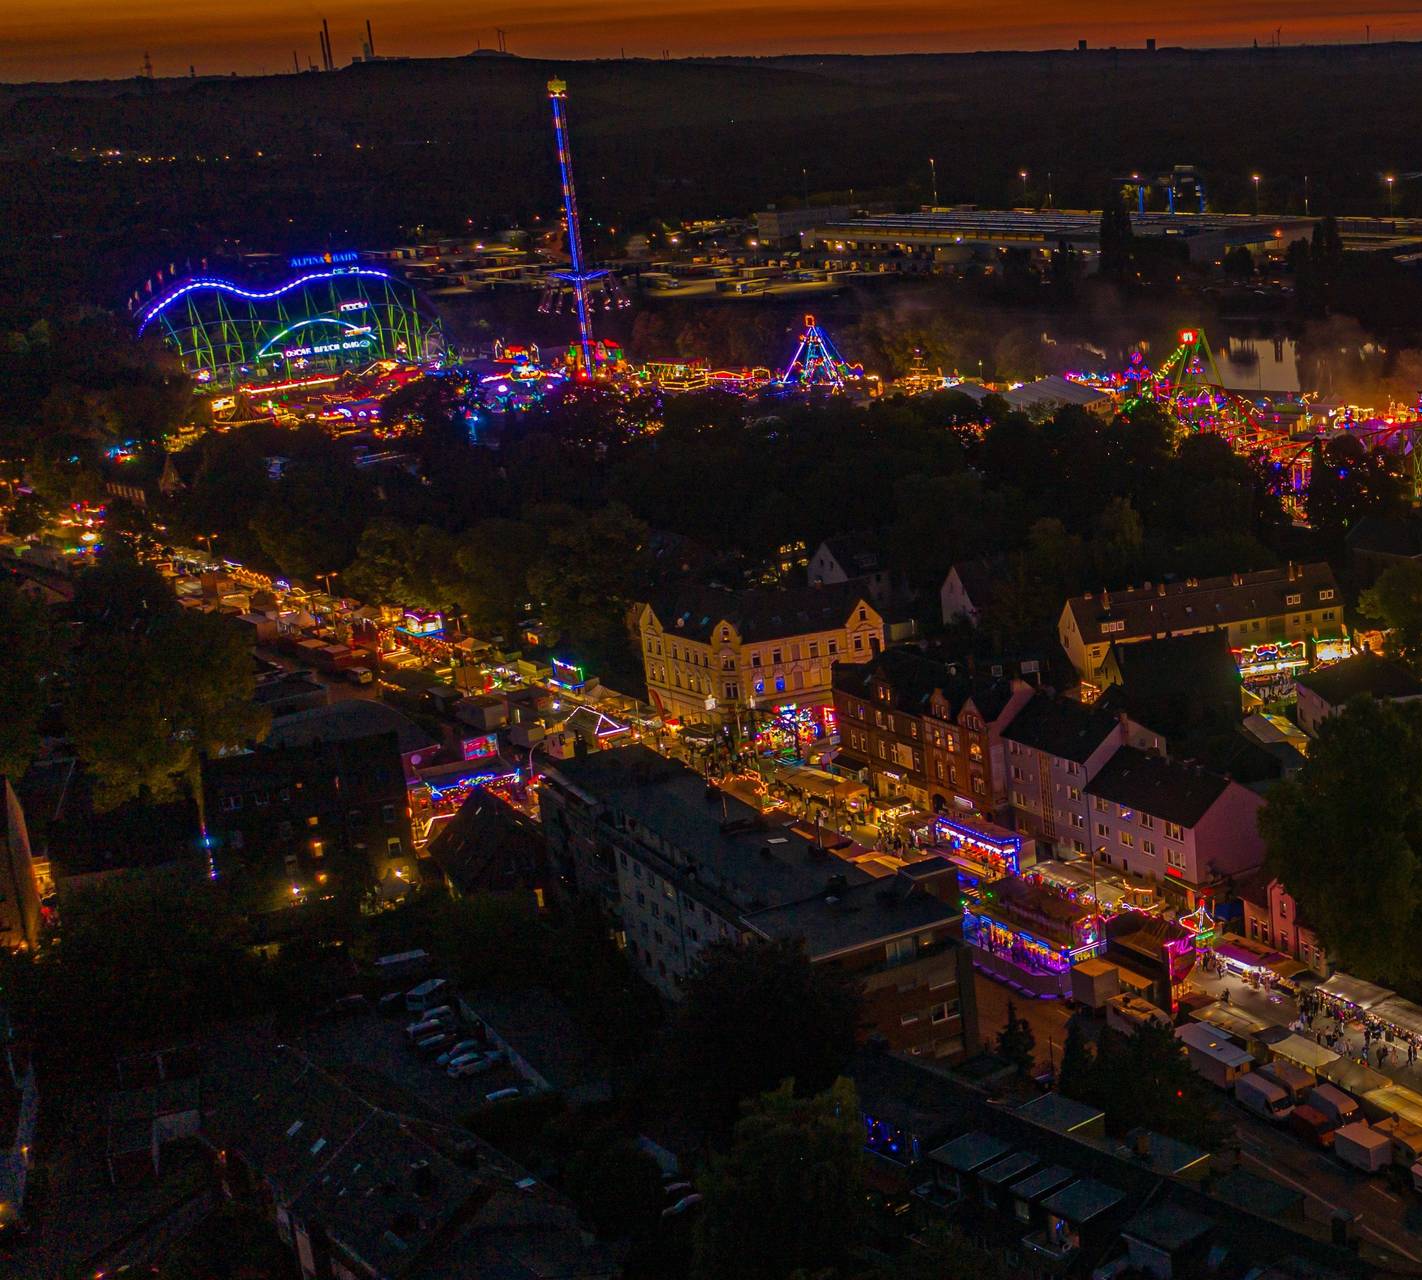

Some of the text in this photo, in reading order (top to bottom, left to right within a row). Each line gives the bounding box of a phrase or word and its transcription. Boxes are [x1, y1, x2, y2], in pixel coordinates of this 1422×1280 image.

[291, 252, 359, 268] ALPINA BAHN
[286, 346, 313, 358] OSCAR
